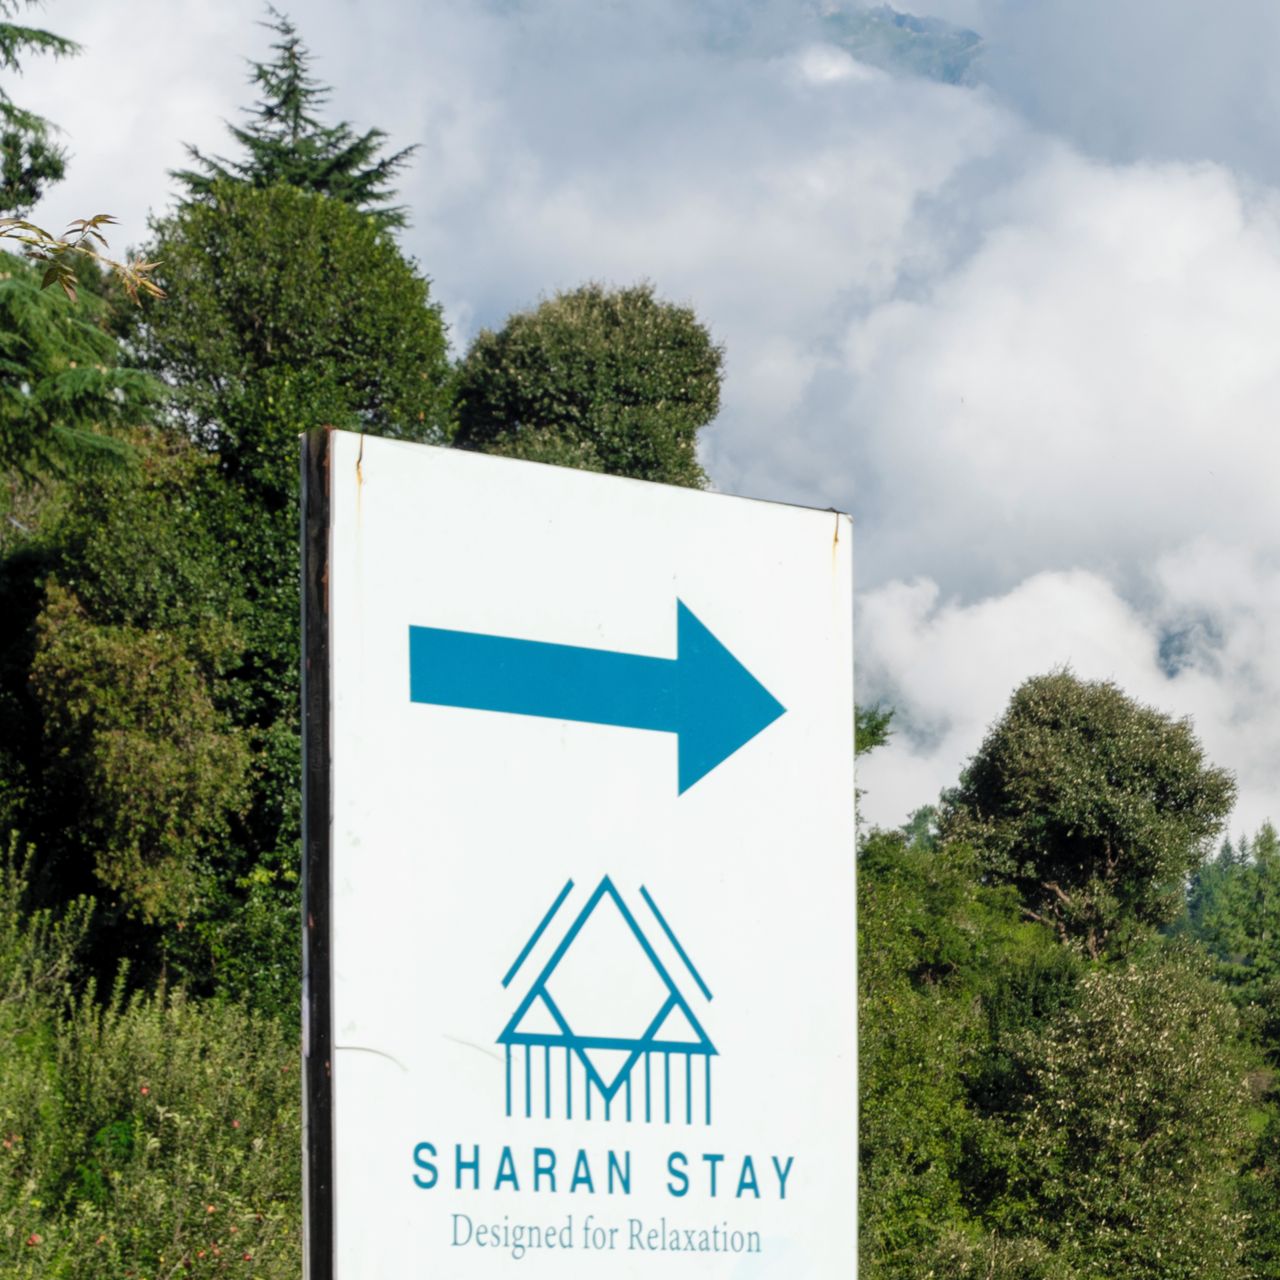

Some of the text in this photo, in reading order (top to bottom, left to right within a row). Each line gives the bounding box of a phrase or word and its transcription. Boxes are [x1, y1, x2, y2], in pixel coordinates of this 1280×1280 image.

[412, 1141, 794, 1199] SHARAN STAY
[452, 1214, 761, 1259] Designed for Relaxation
